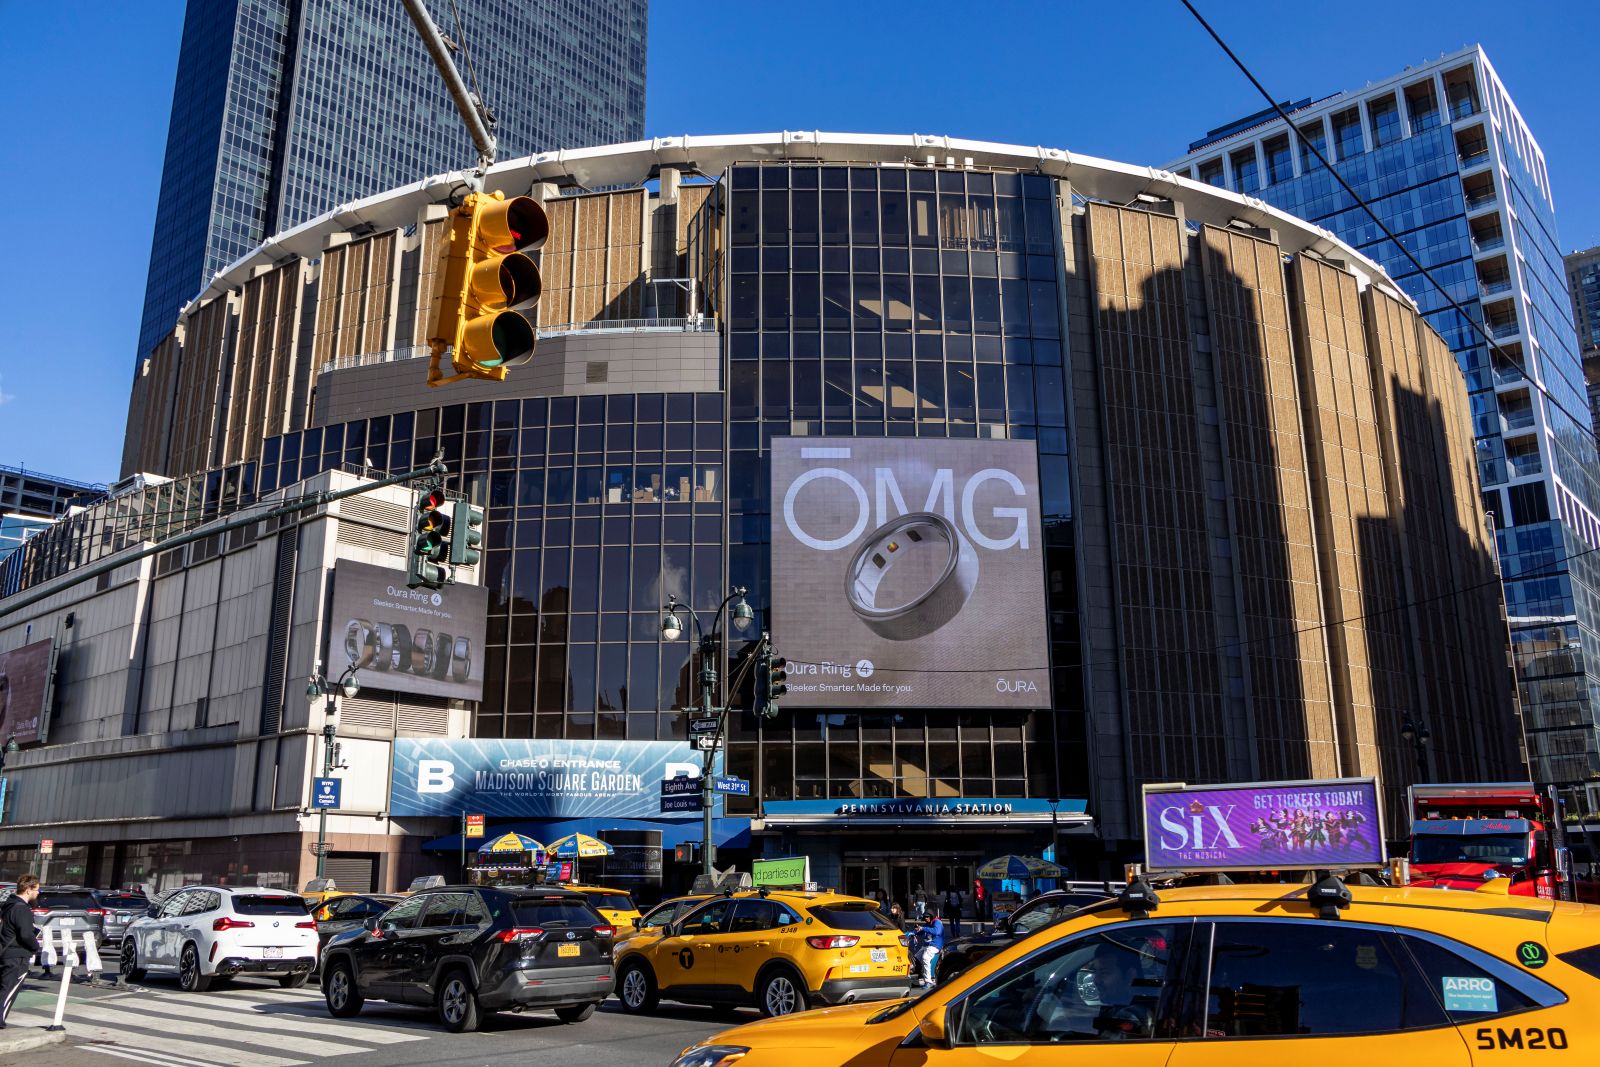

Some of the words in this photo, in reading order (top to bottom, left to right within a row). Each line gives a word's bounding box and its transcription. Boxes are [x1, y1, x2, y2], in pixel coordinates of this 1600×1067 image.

[386, 585, 408, 599] Oura
[409, 589, 429, 605] Ring
[784, 662, 817, 676] Oura
[821, 662, 852, 678] Ring
[785, 683, 818, 693] Sleeker.
[819, 683, 855, 692] Smarter.
[856, 683, 881, 692] Made
[882, 683, 895, 692] for
[895, 684, 913, 695] you.
[500, 759, 537, 768] CHASE
[553, 759, 621, 769] ENTRANCE
[417, 759, 455, 793] B
[475, 770, 534, 791] MADISON
[538, 770, 587, 792] SQUARE
[665, 782, 684, 793] Eighth
[685, 782, 697, 790] Ave
[717, 782, 730, 790] West
[740, 784, 747, 792] St
[664, 801, 673, 809] Joe
[674, 800, 688, 808] Louis
[1254, 794, 1274, 810] GET
[1276, 792, 1321, 809] TICKETS
[1324, 790, 1363, 807] TODAY!
[842, 803, 949, 813] PENNSYLVANIA
[956, 803, 1012, 812] STATION
[763, 867, 789, 882] parties
[789, 868, 801, 878] on
[1445, 978, 1492, 991] ARRO
[1476, 1028, 1569, 1050] 5M20
